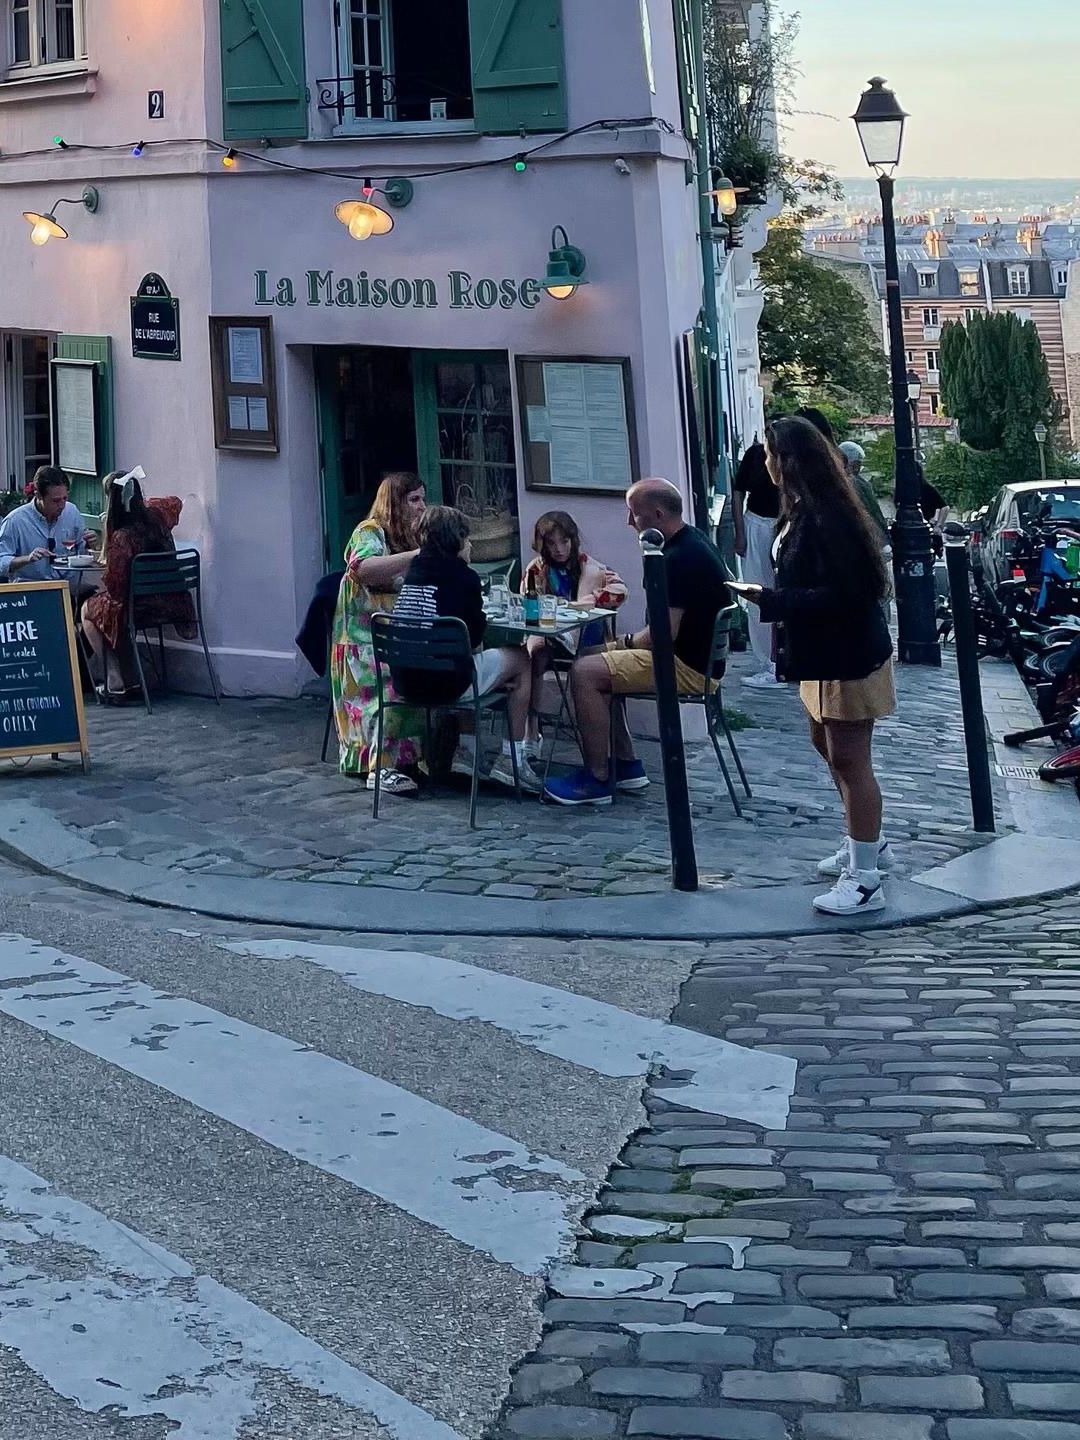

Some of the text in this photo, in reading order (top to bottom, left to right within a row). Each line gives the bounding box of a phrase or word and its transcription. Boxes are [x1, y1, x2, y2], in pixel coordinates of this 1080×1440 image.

[151, 92, 162, 118] 2
[254, 270, 541, 309] La Maison Rose
[148, 312, 160, 323] RUE
[135, 328, 176, 341] DE L'ABREUVOIR
[3, 715, 37, 733] ONLY
